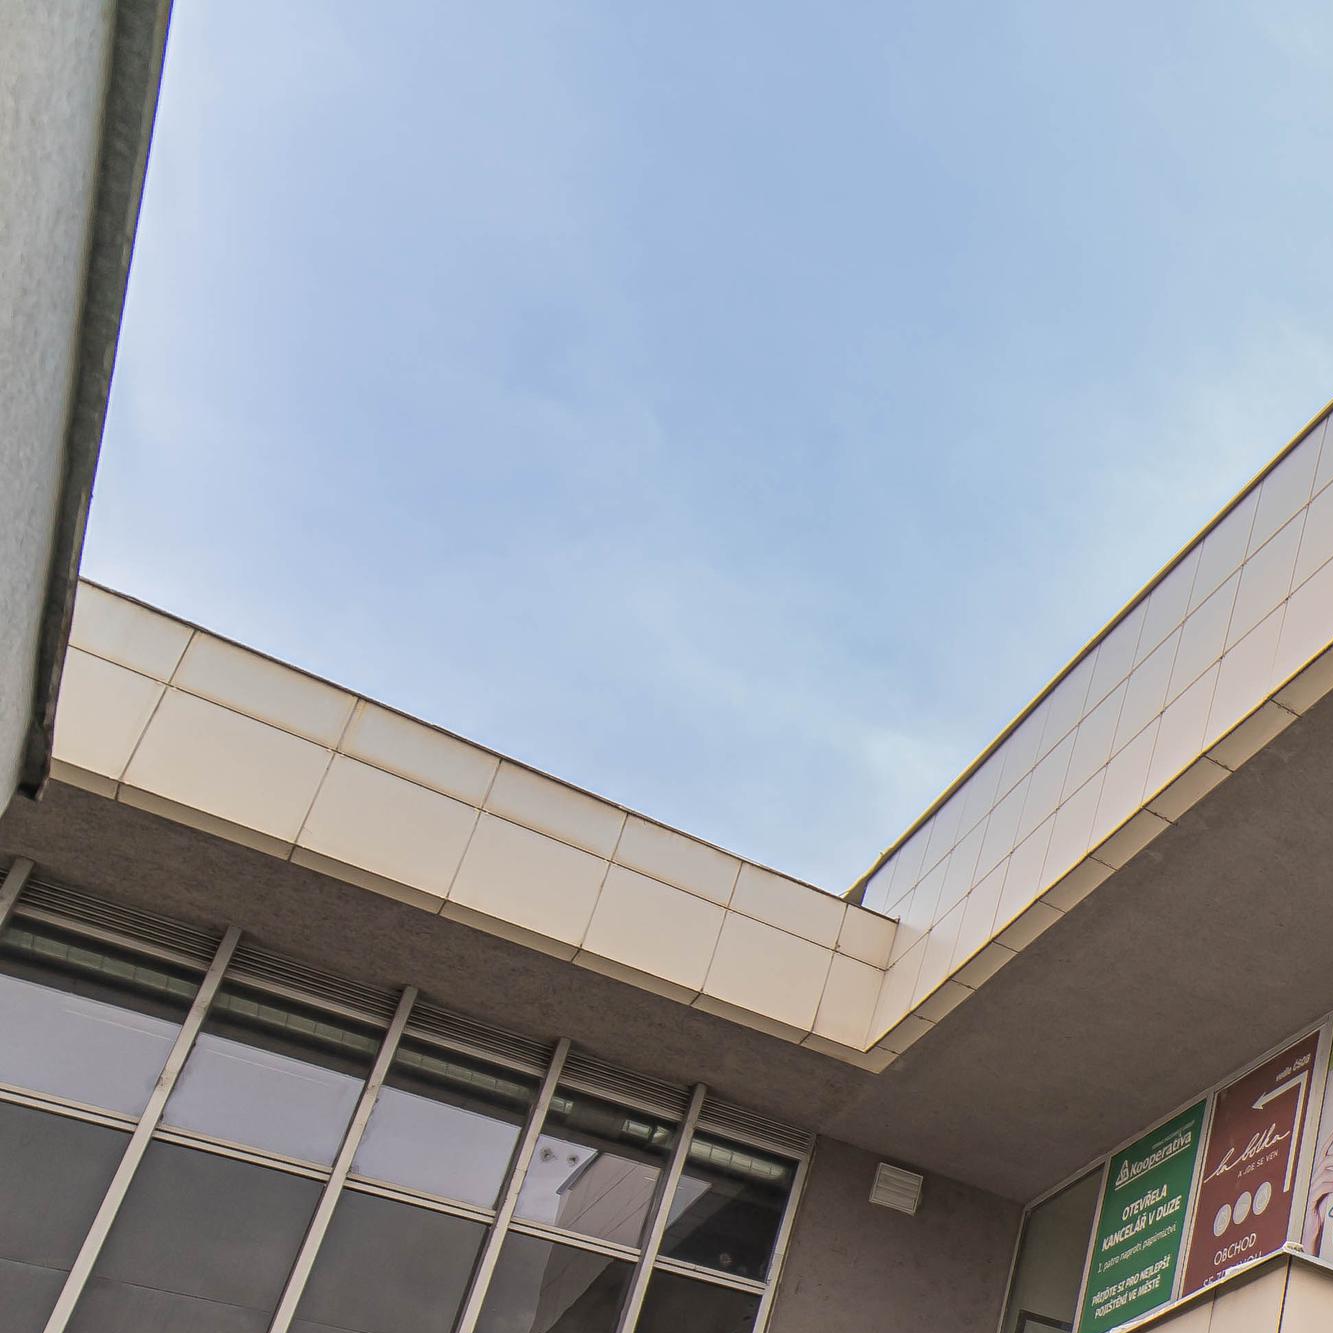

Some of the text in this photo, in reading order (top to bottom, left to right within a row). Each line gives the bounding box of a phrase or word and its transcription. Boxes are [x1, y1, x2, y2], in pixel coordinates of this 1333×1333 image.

[1130, 1130, 1192, 1178] Kooperativa
[1102, 1195, 1182, 1251] KANCELÁŘ V DUZE
[1122, 1184, 1168, 1221] OTEVŘELA
[1213, 1232, 1256, 1266] OBCHOD
